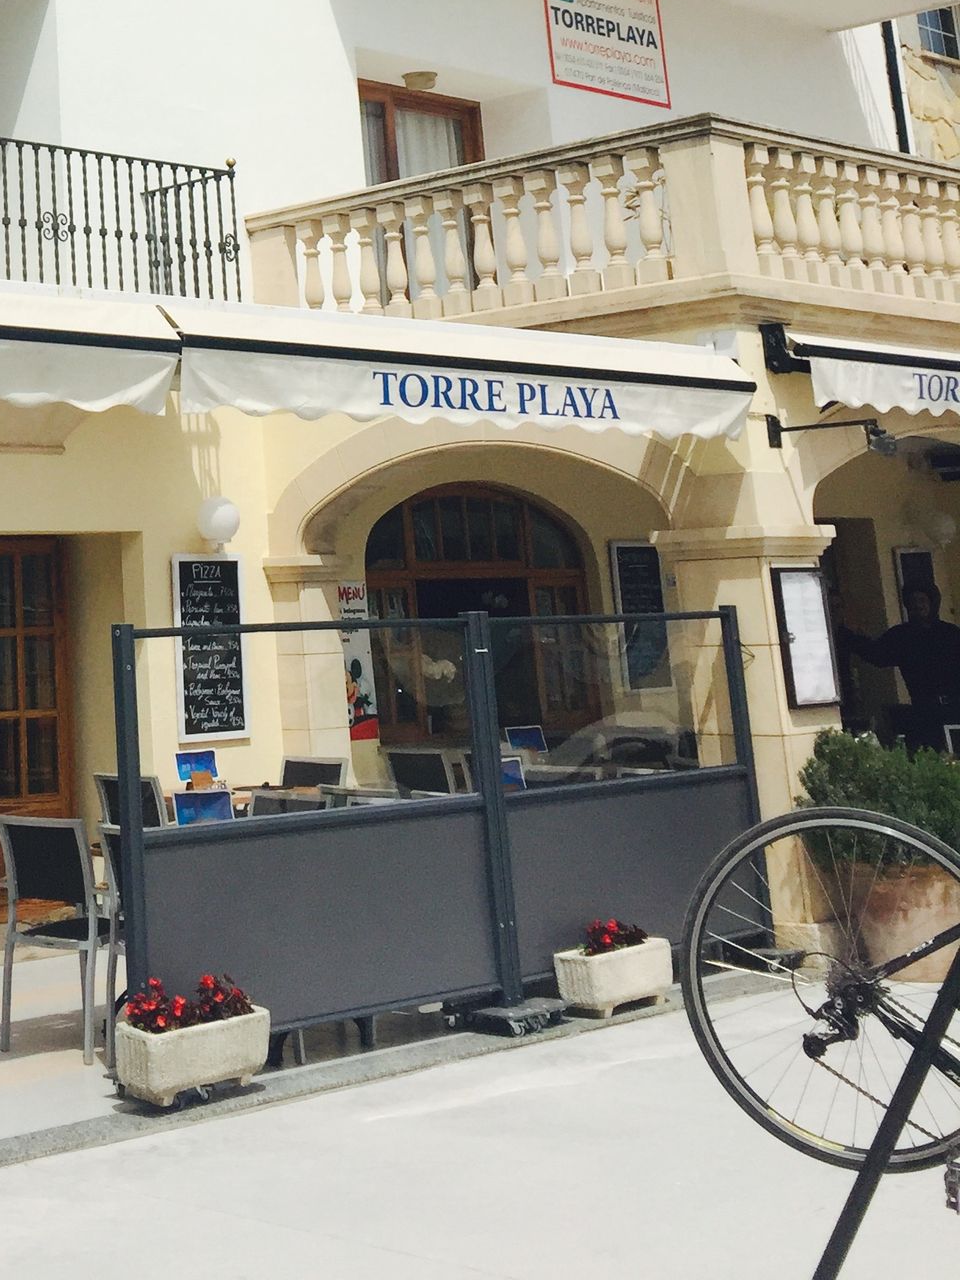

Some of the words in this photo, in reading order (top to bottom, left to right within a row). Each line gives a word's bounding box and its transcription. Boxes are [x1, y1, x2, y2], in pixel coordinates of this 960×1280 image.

[550, 5, 658, 49] TORREPLAYA
[560, 37, 656, 69] www.torreplaya.com
[373, 371, 507, 412] TORRE
[516, 382, 620, 420] PLAYA
